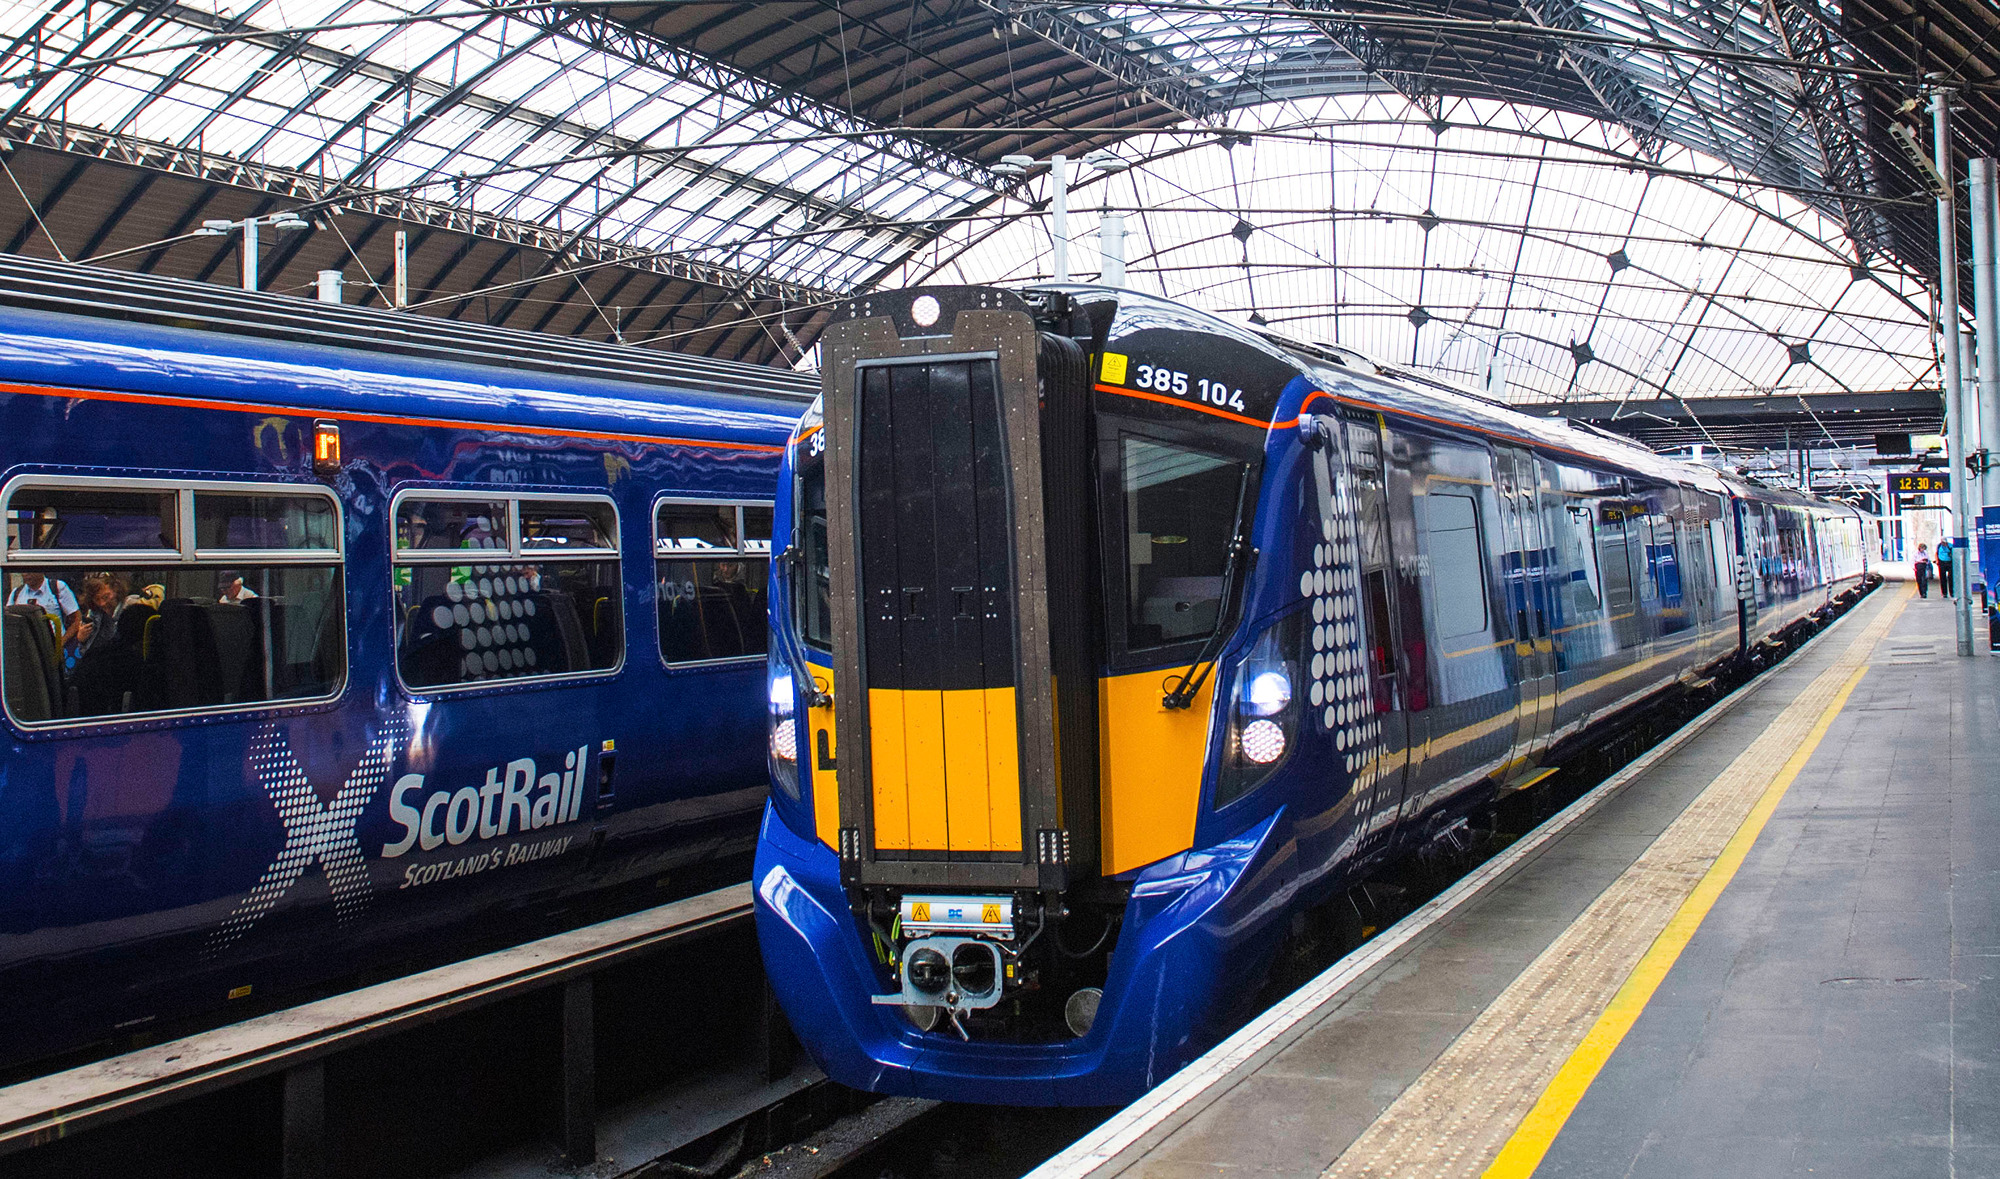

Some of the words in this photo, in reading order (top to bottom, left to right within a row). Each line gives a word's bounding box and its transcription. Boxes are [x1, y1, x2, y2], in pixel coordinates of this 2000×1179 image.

[1135, 364, 1188, 395] 385
[1198, 379, 1245, 412] 104
[810, 427, 825, 457] 38
[1899, 477, 1929, 490] 12:30
[380, 744, 588, 858] ScotRail
[503, 836, 573, 867] RAILWAY
